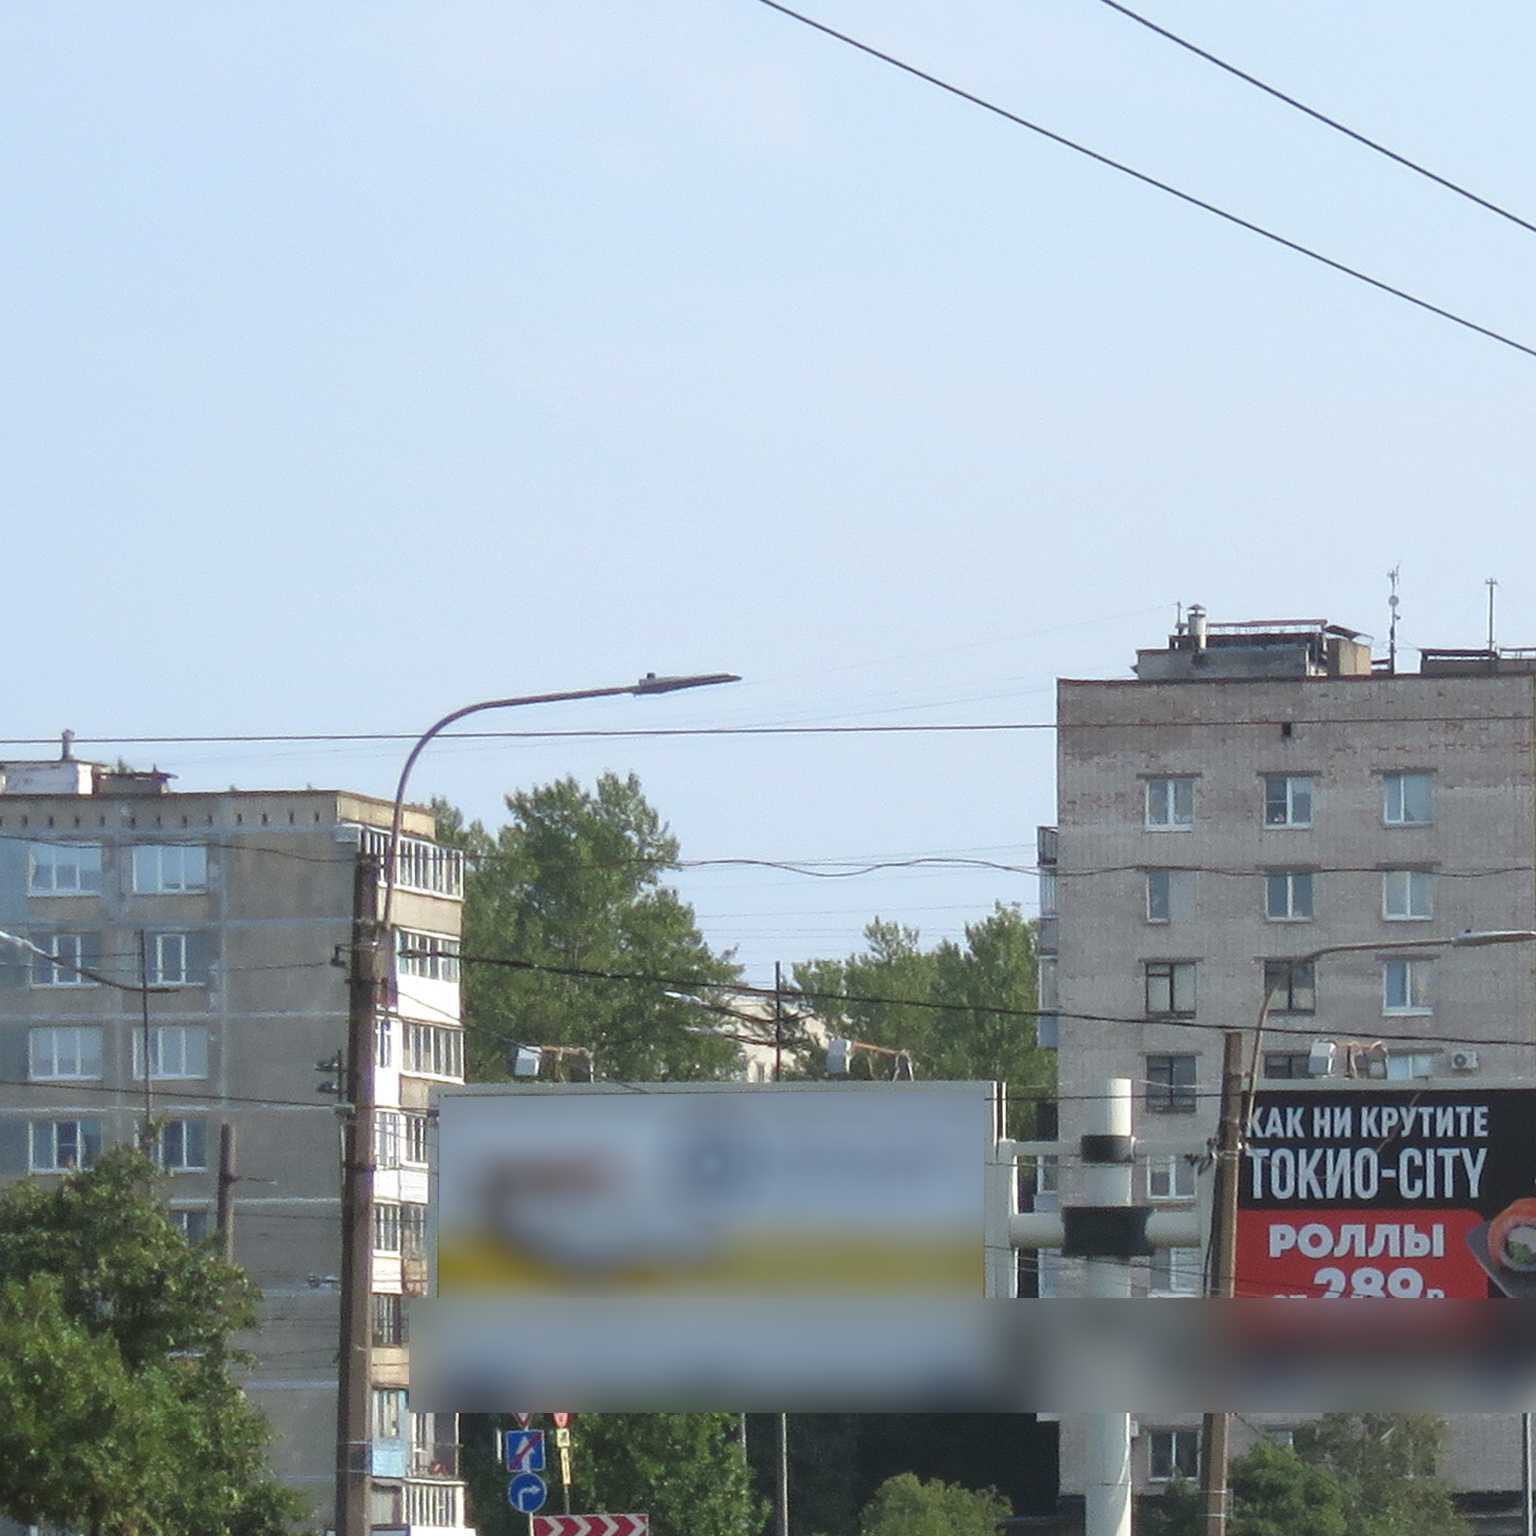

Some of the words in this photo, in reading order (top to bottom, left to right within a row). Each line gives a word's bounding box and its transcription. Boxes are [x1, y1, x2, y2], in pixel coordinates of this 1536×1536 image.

[1246, 1107, 1304, 1138] КАК
[1313, 1107, 1352, 1138] НИ
[1361, 1106, 1489, 1138] КРУТИТЕ
[1246, 1147, 1487, 1200] ТОКИО-CITY
[1269, 1223, 1445, 1259] РОЛЛЫ
